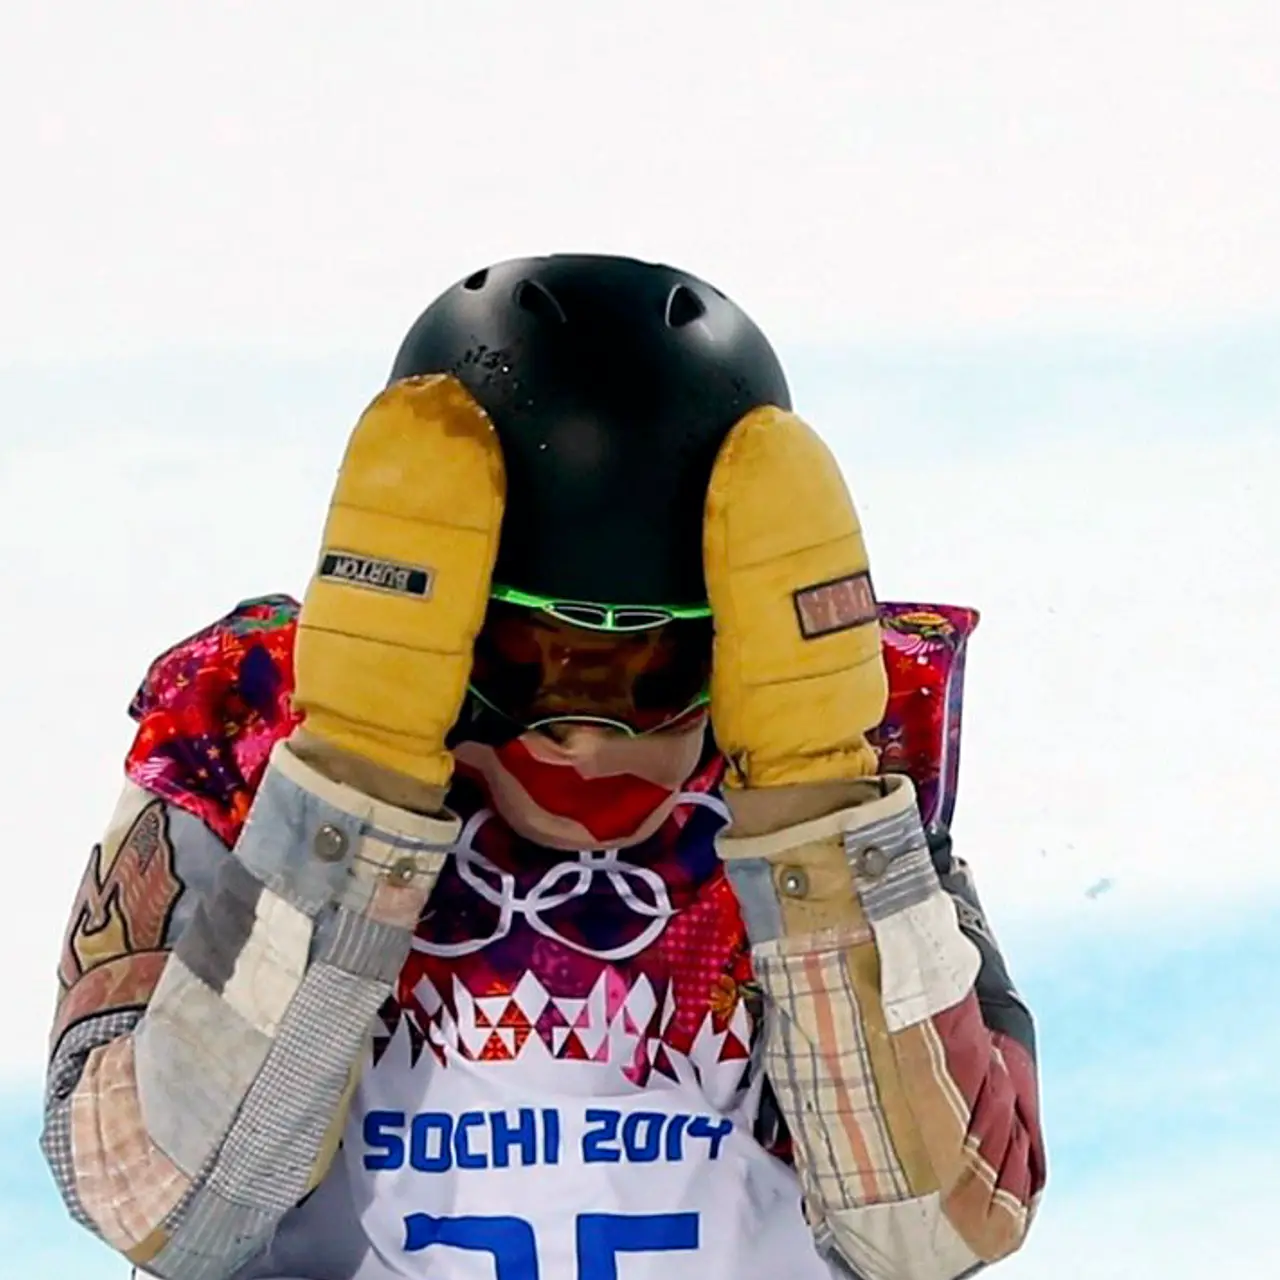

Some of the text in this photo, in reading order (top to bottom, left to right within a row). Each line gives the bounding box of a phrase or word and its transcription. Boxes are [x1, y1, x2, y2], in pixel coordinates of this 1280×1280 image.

[332, 557, 411, 591] BURTON
[363, 1108, 733, 1173] SOCHI 2014
